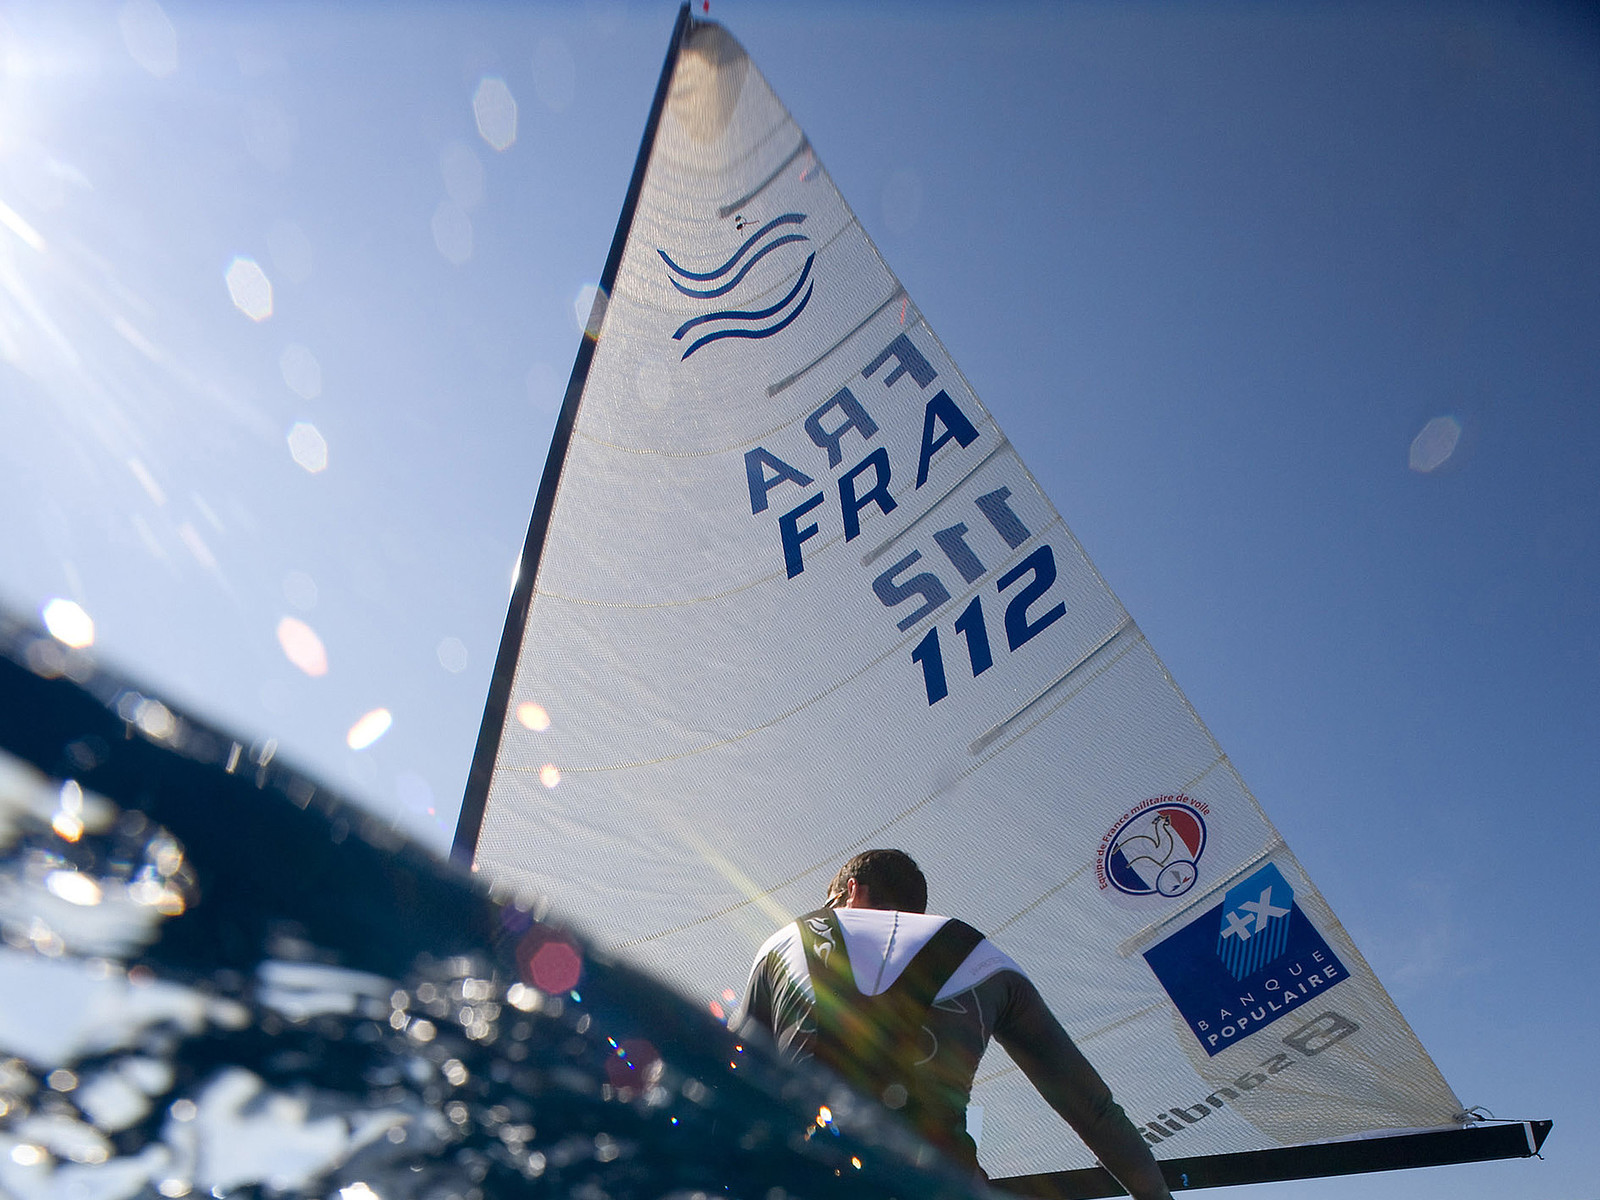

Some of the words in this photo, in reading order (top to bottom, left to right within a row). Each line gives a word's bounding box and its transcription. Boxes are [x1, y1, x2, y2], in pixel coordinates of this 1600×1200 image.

[778, 388, 980, 580] FRA
[911, 543, 1067, 706] 112
[1096, 843, 1107, 857] de
[1102, 813, 1130, 843] France
[1130, 794, 1174, 815] militaire
[1176, 793, 1189, 803] de
[1191, 798, 1211, 816] voile
[1197, 949, 1325, 1031] BANQUE
[1207, 964, 1338, 1047] POPULAIRE
